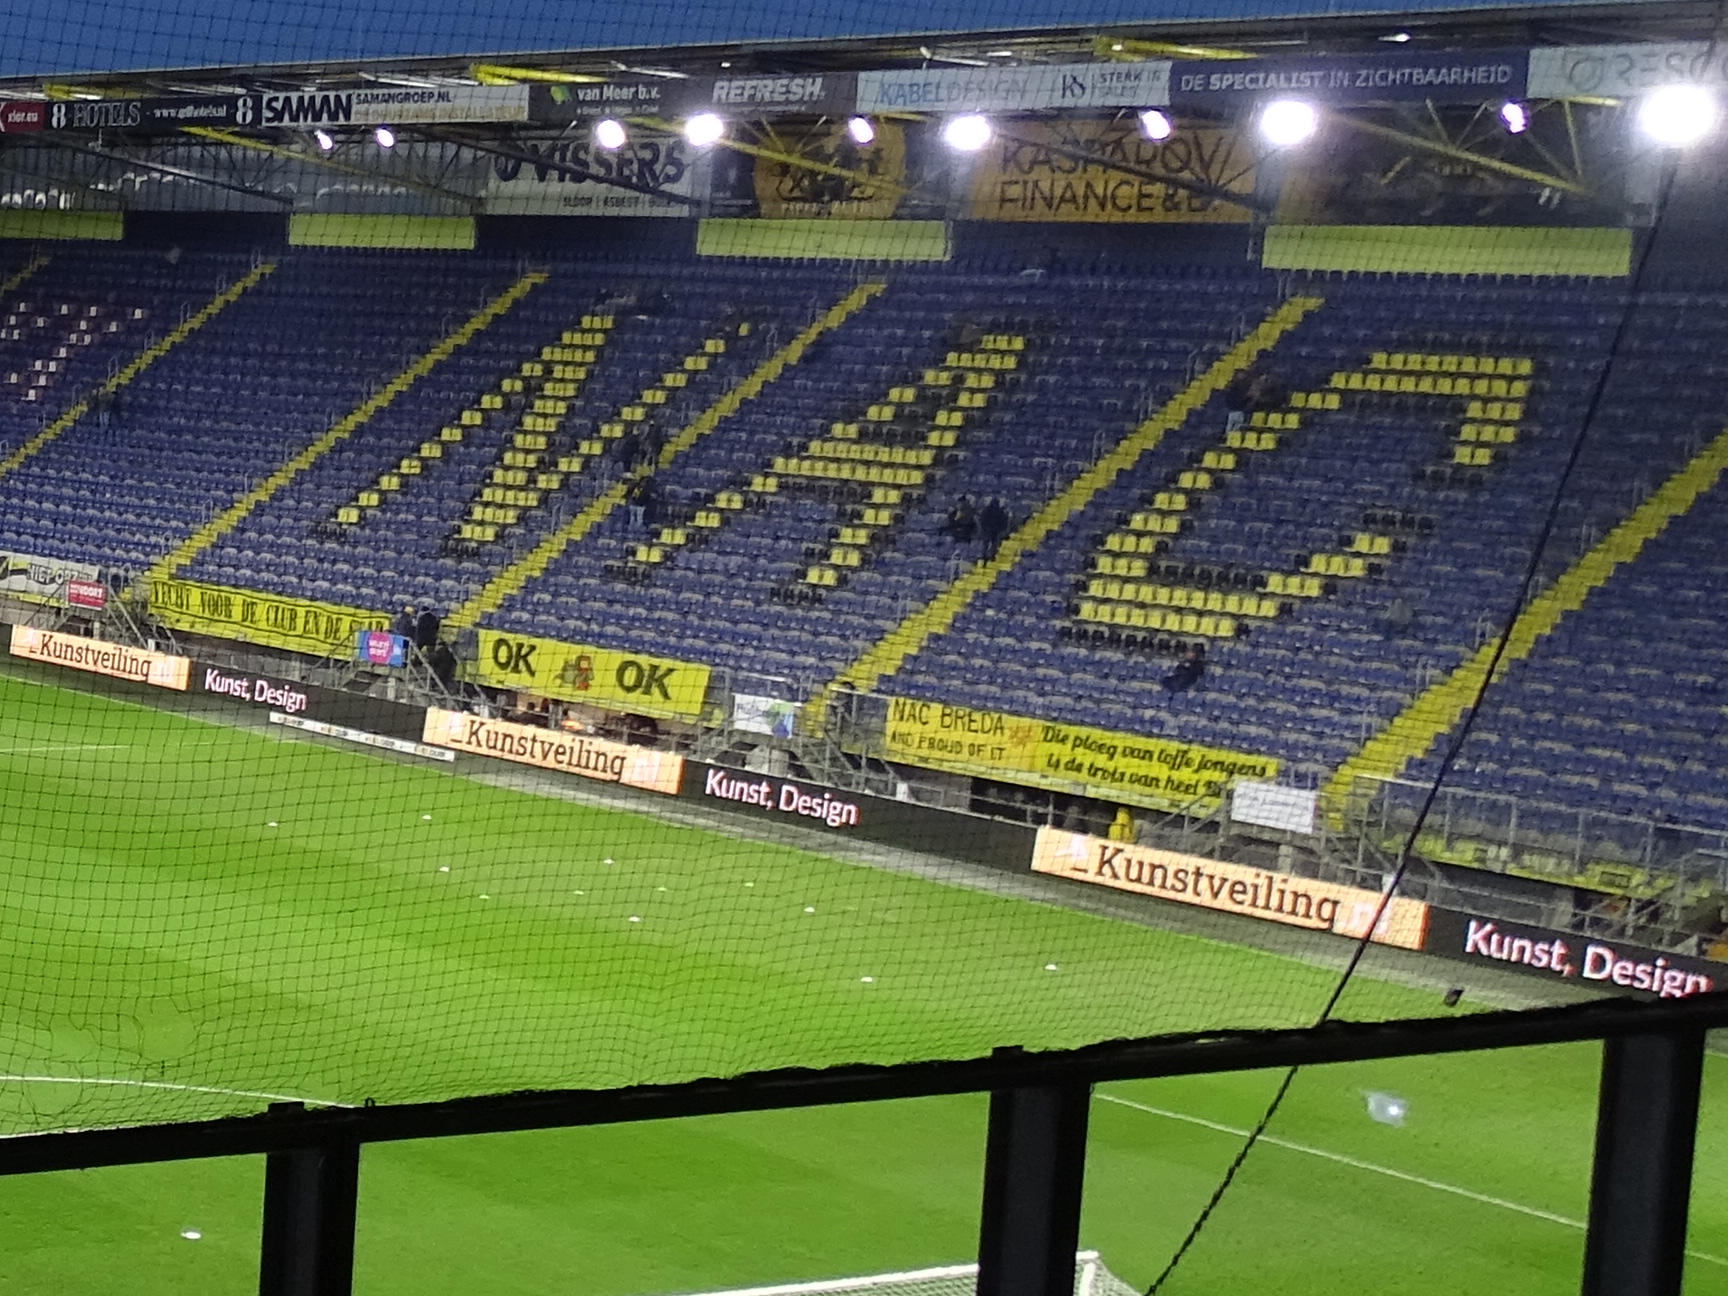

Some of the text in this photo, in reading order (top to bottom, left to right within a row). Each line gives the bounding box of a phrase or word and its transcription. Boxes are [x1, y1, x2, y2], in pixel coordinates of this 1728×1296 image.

[577, 87, 600, 101] van
[602, 84, 637, 101] Meer
[1181, 73, 1204, 91] DE
[1208, 70, 1324, 90] SPECIALIST
[1354, 64, 1514, 87] ZICHTBAARHEID
[72, 101, 142, 128] HOTELS
[264, 92, 353, 123] SAMAN
[355, 90, 452, 105] SAMANGROEP.NL
[998, 179, 1155, 214] FINANCE
[199, 590, 232, 620] VOOR
[241, 596, 258, 624] DE
[265, 599, 298, 633] CLUB
[302, 609, 321, 635] EN
[323, 613, 342, 641] DE
[492, 637, 678, 702] OK OK
[204, 669, 307, 713] Kunst, Design
[892, 697, 1005, 737] NAC BREDA
[918, 736, 963, 755] PROUD
[968, 742, 985, 757] OF
[1042, 725, 1070, 746] Die
[1071, 733, 1119, 761] ploeg
[1121, 745, 1153, 764] van
[1156, 747, 1194, 773] toffe
[704, 768, 861, 828] Kunst, Design
[1128, 769, 1161, 788] van
[1165, 775, 1199, 796] heel
[1464, 918, 1716, 1000] Kunst, Design
